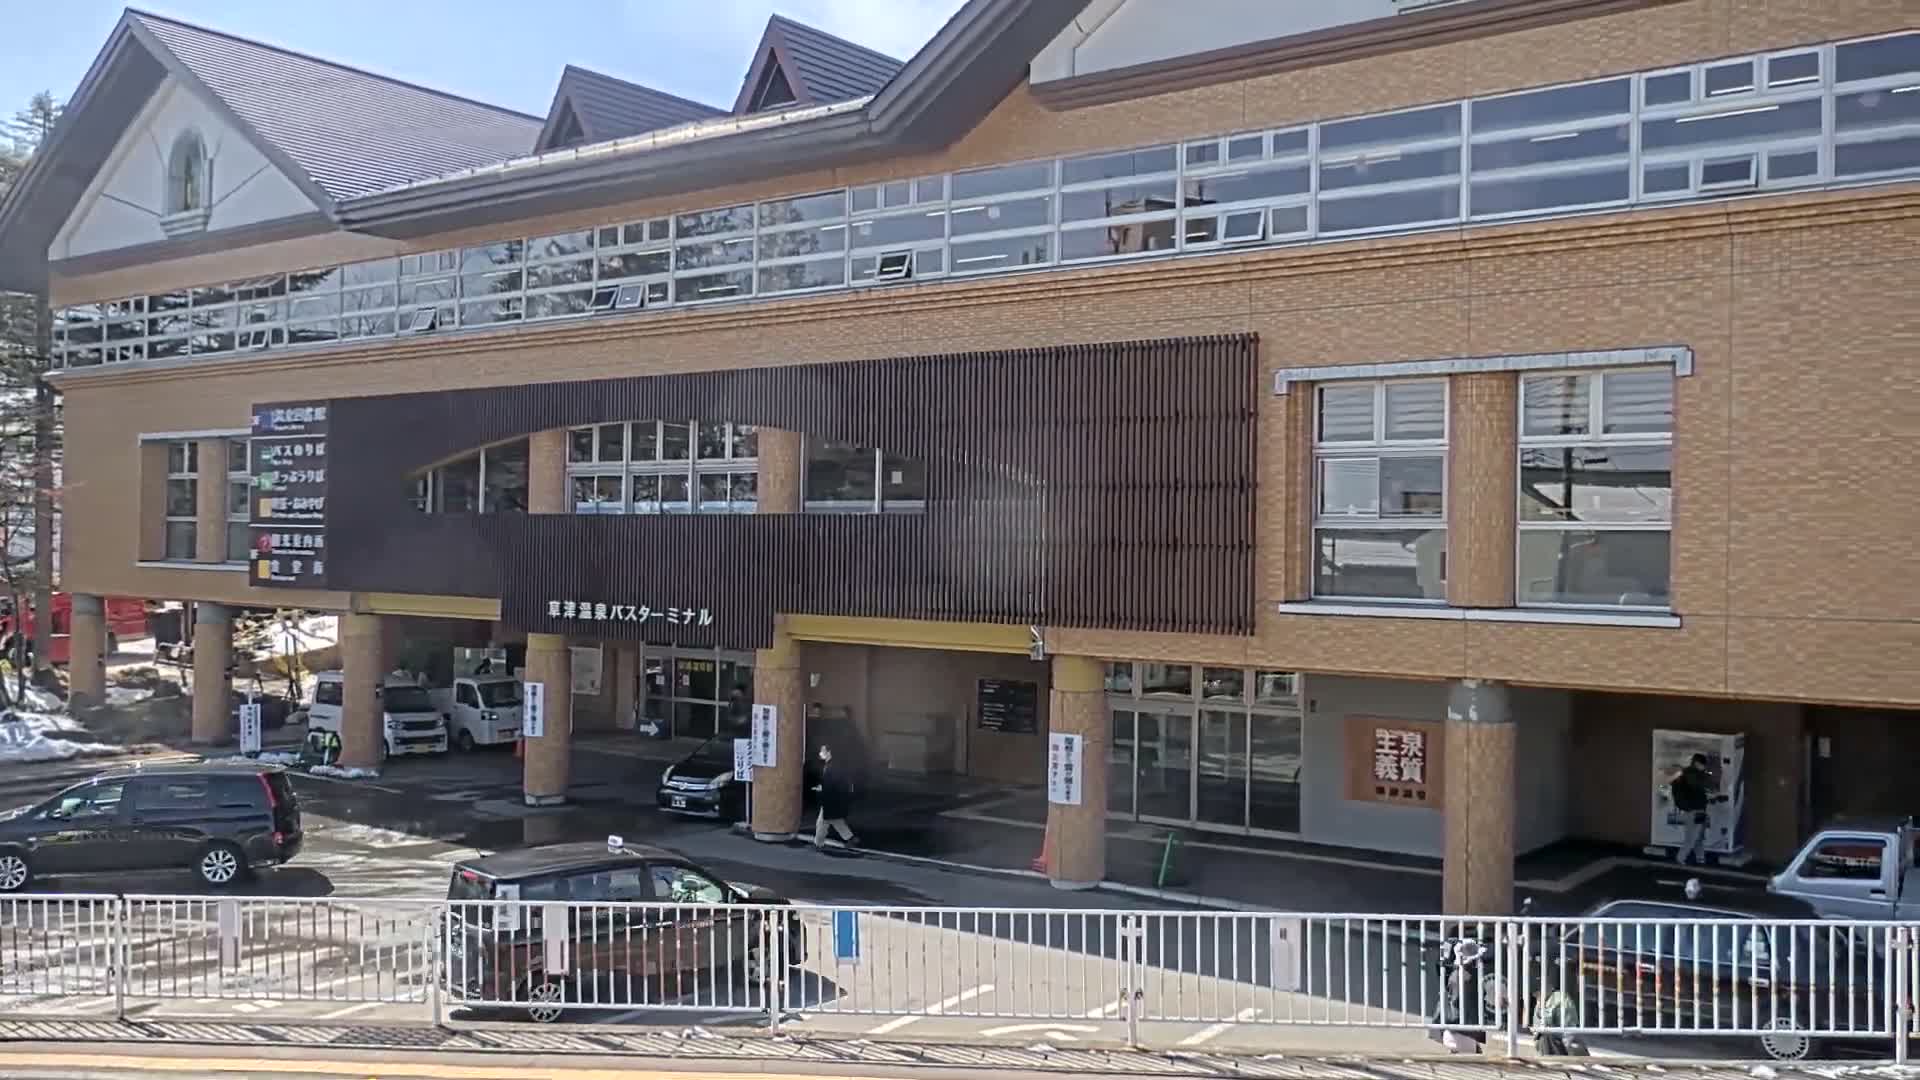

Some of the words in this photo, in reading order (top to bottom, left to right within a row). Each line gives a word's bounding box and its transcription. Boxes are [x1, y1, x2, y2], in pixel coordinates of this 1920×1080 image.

[272, 442, 326, 457] バスのりば
[547, 600, 713, 627] 草津温泉バスターミナル
